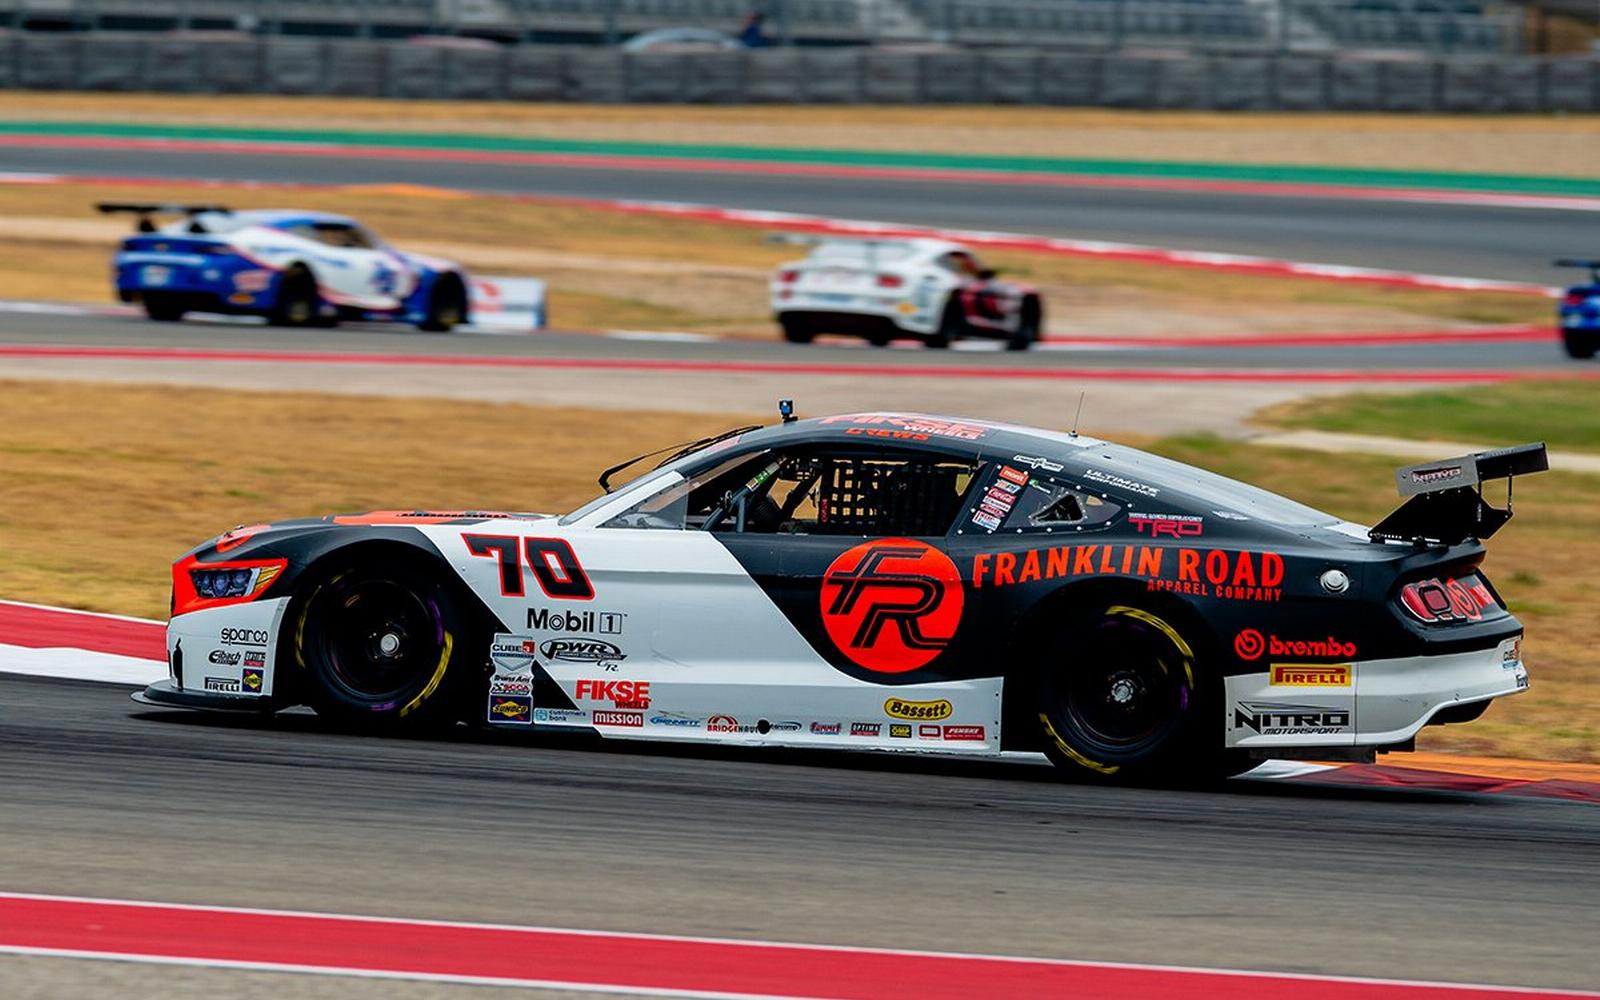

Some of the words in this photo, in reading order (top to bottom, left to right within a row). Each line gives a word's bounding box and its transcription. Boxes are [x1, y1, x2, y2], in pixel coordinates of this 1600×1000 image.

[1085, 469, 1161, 495] ULTIMATE
[1127, 519, 1204, 539] TRD
[460, 532, 596, 601] 70
[972, 545, 1163, 588] FRANKLIN
[1178, 548, 1285, 587] ROAD
[1147, 578, 1209, 596] APPAREL
[1215, 584, 1284, 601] COMPANY
[527, 607, 595, 633] Mobil
[221, 627, 269, 646] sparco
[1270, 635, 1356, 656] brembo
[548, 641, 607, 660] PWR
[204, 677, 240, 692] PIRELLI
[1274, 667, 1346, 684] PIRELLI
[575, 679, 650, 702] FIKSE
[891, 701, 947, 717] Bassett
[1235, 708, 1350, 734] NITRO
[1263, 727, 1342, 735] MOTORSPORT
